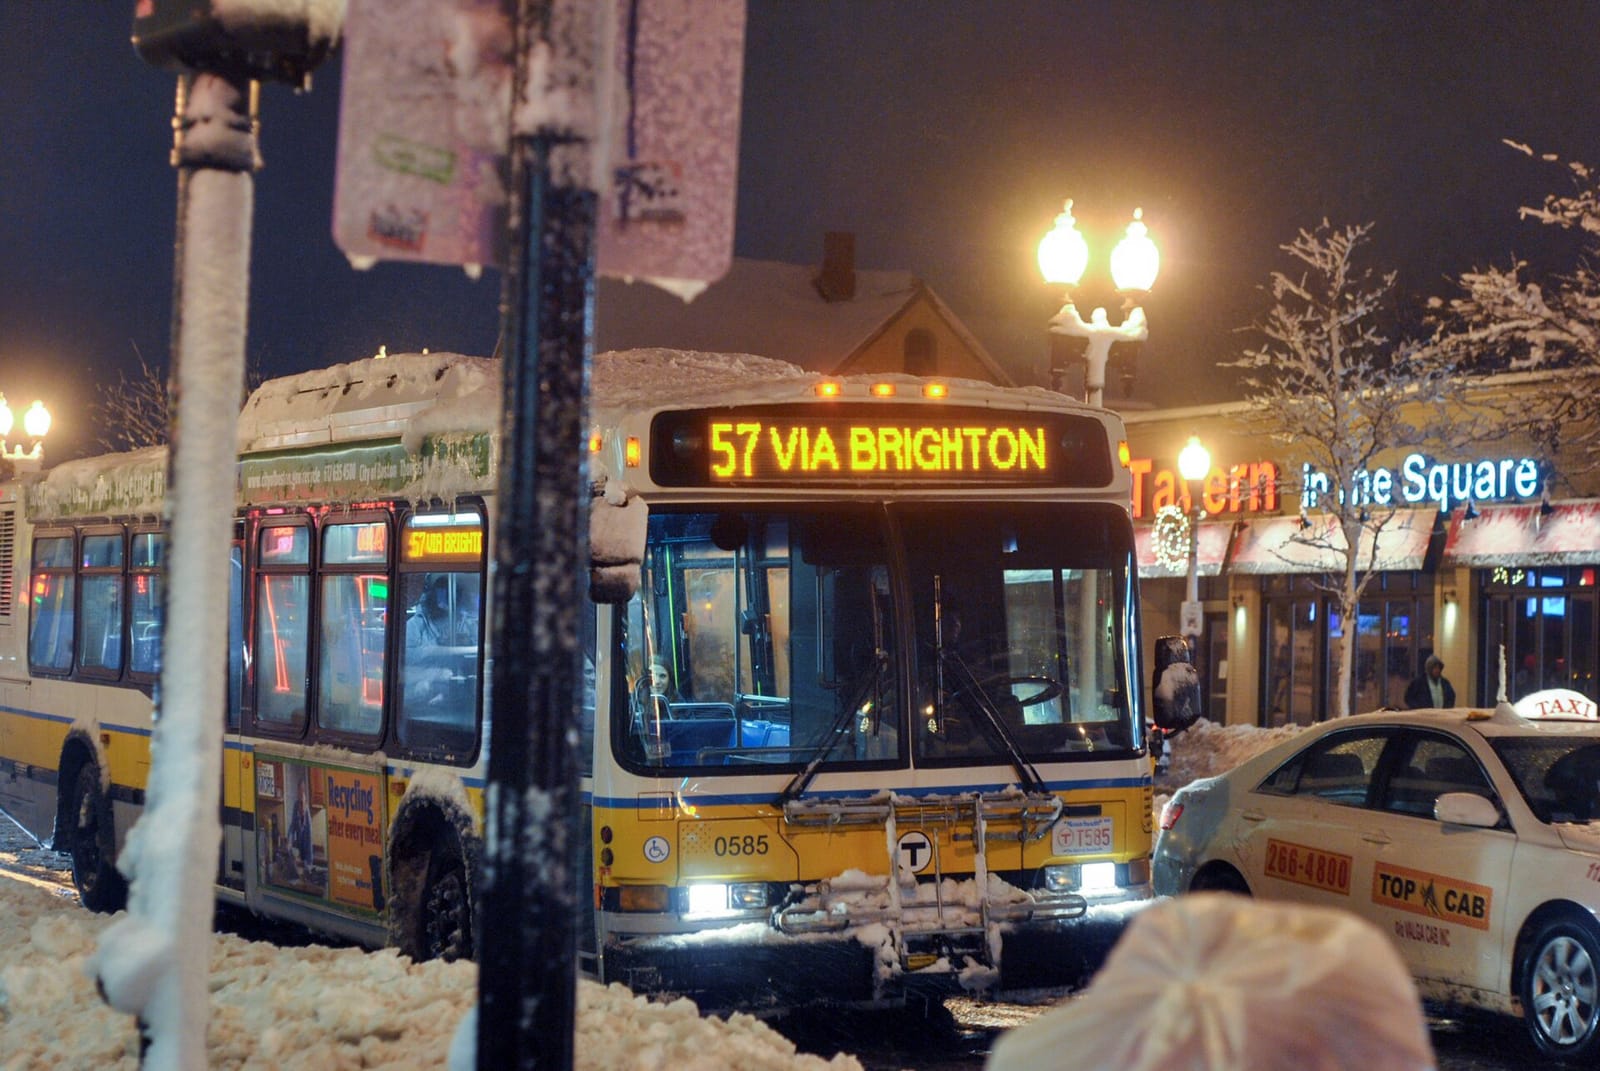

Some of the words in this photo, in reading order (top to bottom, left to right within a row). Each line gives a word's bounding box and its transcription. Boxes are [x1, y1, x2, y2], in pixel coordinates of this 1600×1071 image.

[712, 423, 760, 477] 57
[770, 427, 839, 471] VIA
[850, 427, 1046, 471] BRIGHTON
[1302, 462, 1328, 508] in
[1338, 465, 1392, 505] he
[1402, 453, 1538, 513] Square
[1536, 698, 1592, 718] TAXI
[328, 775, 374, 825] Recycling
[328, 814, 344, 838] after
[345, 822, 364, 848] every
[714, 834, 769, 857] 0585
[1077, 827, 1111, 847] T585
[1267, 843, 1349, 888] 266-4800
[1379, 872, 1417, 901] TOP
[1444, 889, 1487, 919] CAB
